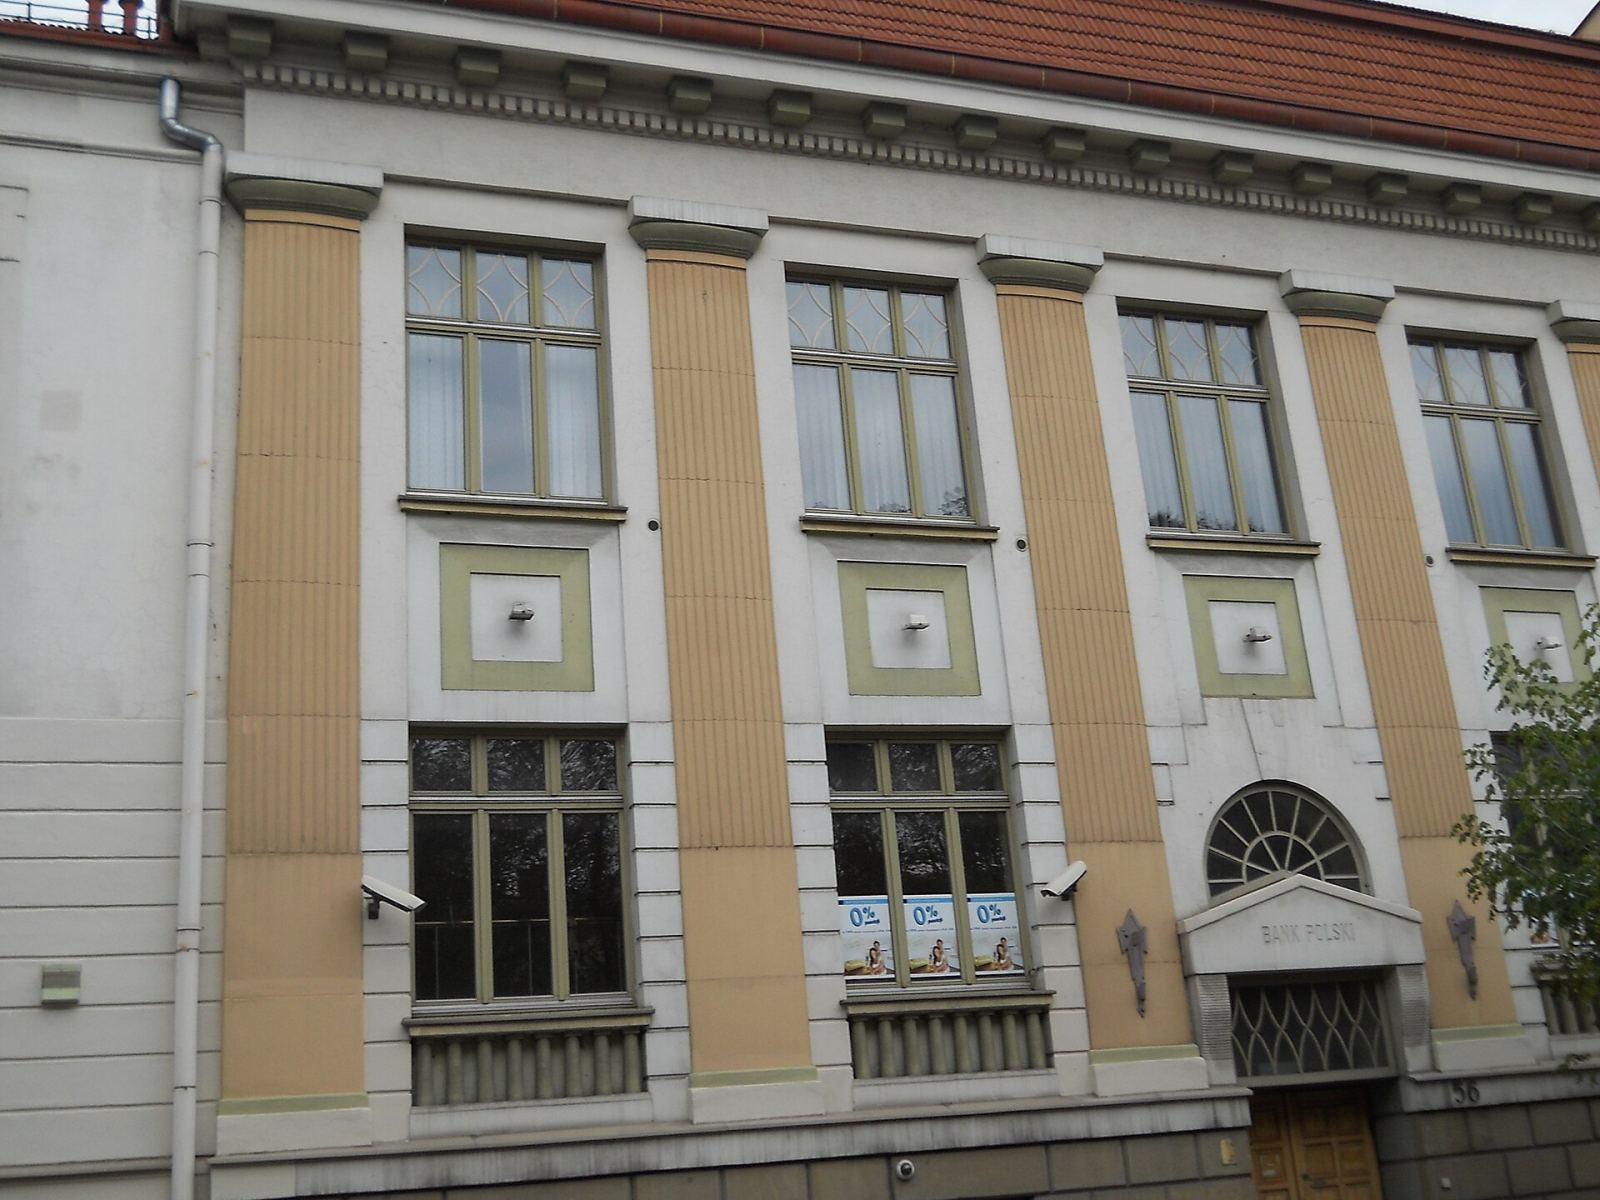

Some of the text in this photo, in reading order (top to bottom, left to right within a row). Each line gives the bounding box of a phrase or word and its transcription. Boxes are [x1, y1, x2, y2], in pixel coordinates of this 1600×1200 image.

[850, 906, 876, 927] 0%
[913, 905, 939, 926] 0%
[977, 904, 1001, 924] 0%
[1262, 922, 1356, 944] BANK POLSKI
